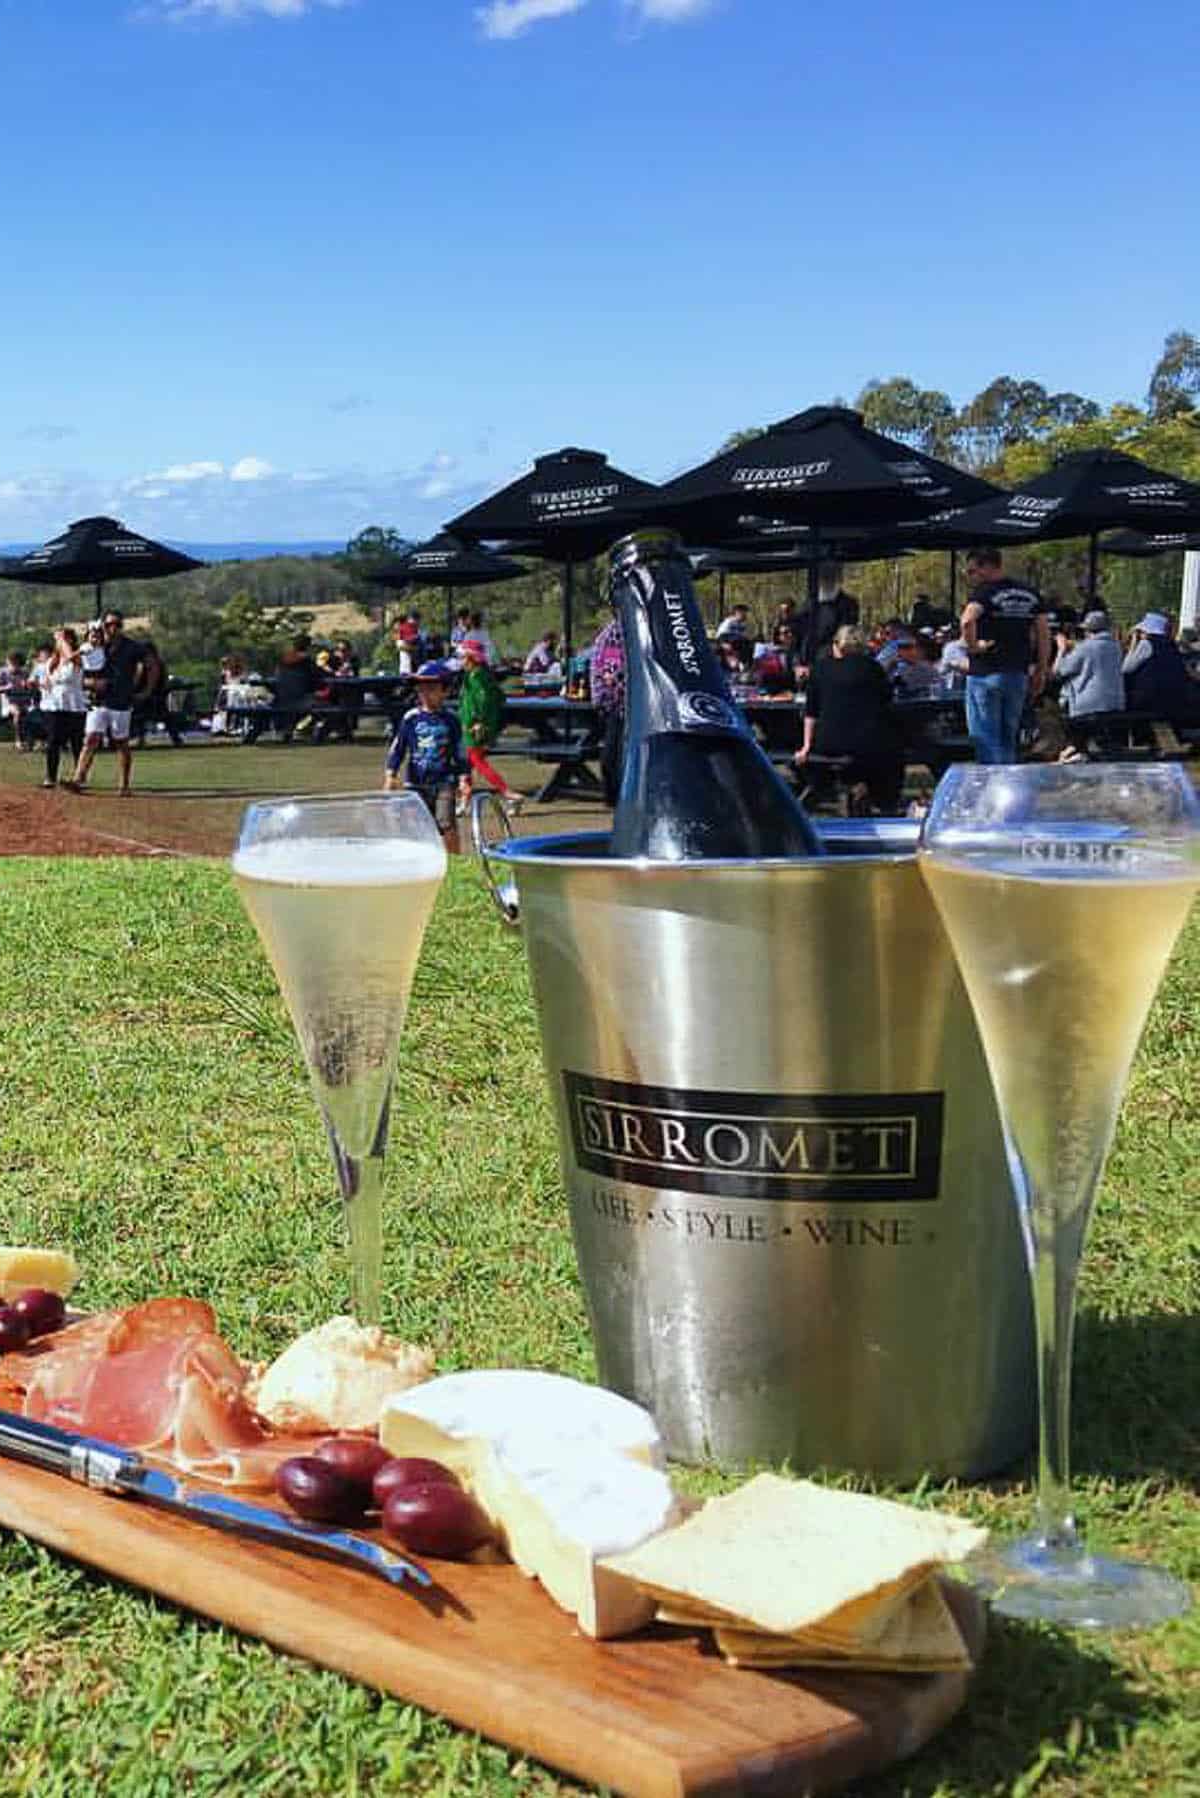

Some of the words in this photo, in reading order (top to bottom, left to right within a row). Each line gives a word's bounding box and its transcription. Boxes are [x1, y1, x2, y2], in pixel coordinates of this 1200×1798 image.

[663, 590, 701, 676] SIRROMET
[584, 1103, 906, 1169] SIRROMET
[662, 1207, 767, 1243] STYLE
[803, 1217, 913, 1246] WINE
